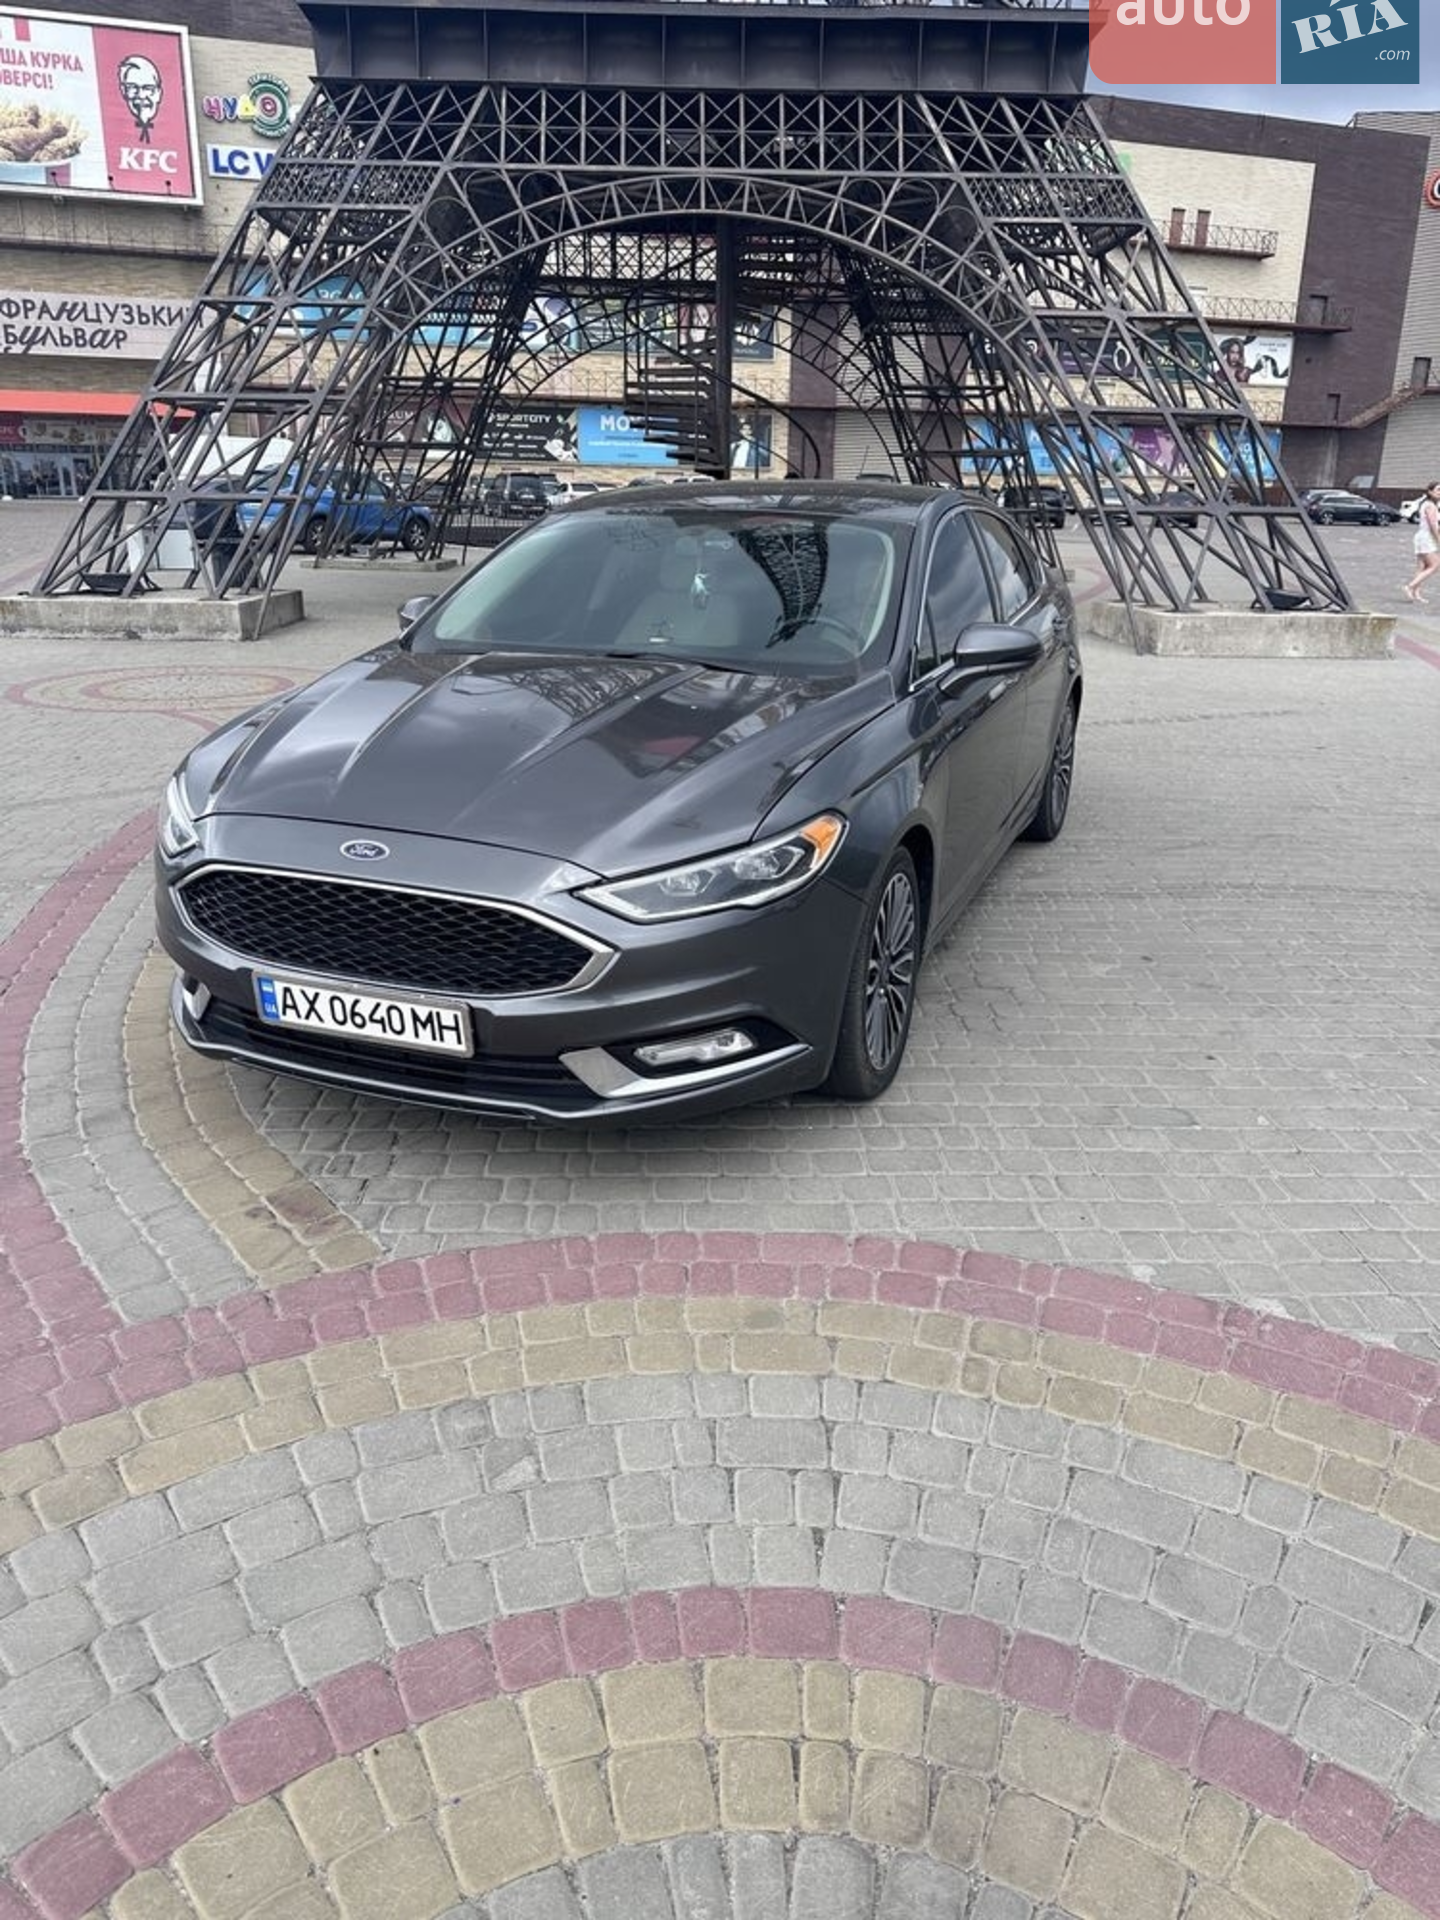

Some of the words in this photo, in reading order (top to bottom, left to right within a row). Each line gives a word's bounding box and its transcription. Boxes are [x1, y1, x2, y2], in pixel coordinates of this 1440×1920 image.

[30, 50, 84, 72] КУРКА
[0, 68, 54, 90] ВЕРСІ!
[118, 147, 178, 174] KFC
[212, 148, 250, 176] LC
[265, 1002, 278, 1015] UA
[281, 986, 324, 1023] AX
[329, 995, 405, 1036] 0640
[411, 1007, 462, 1045] MH
